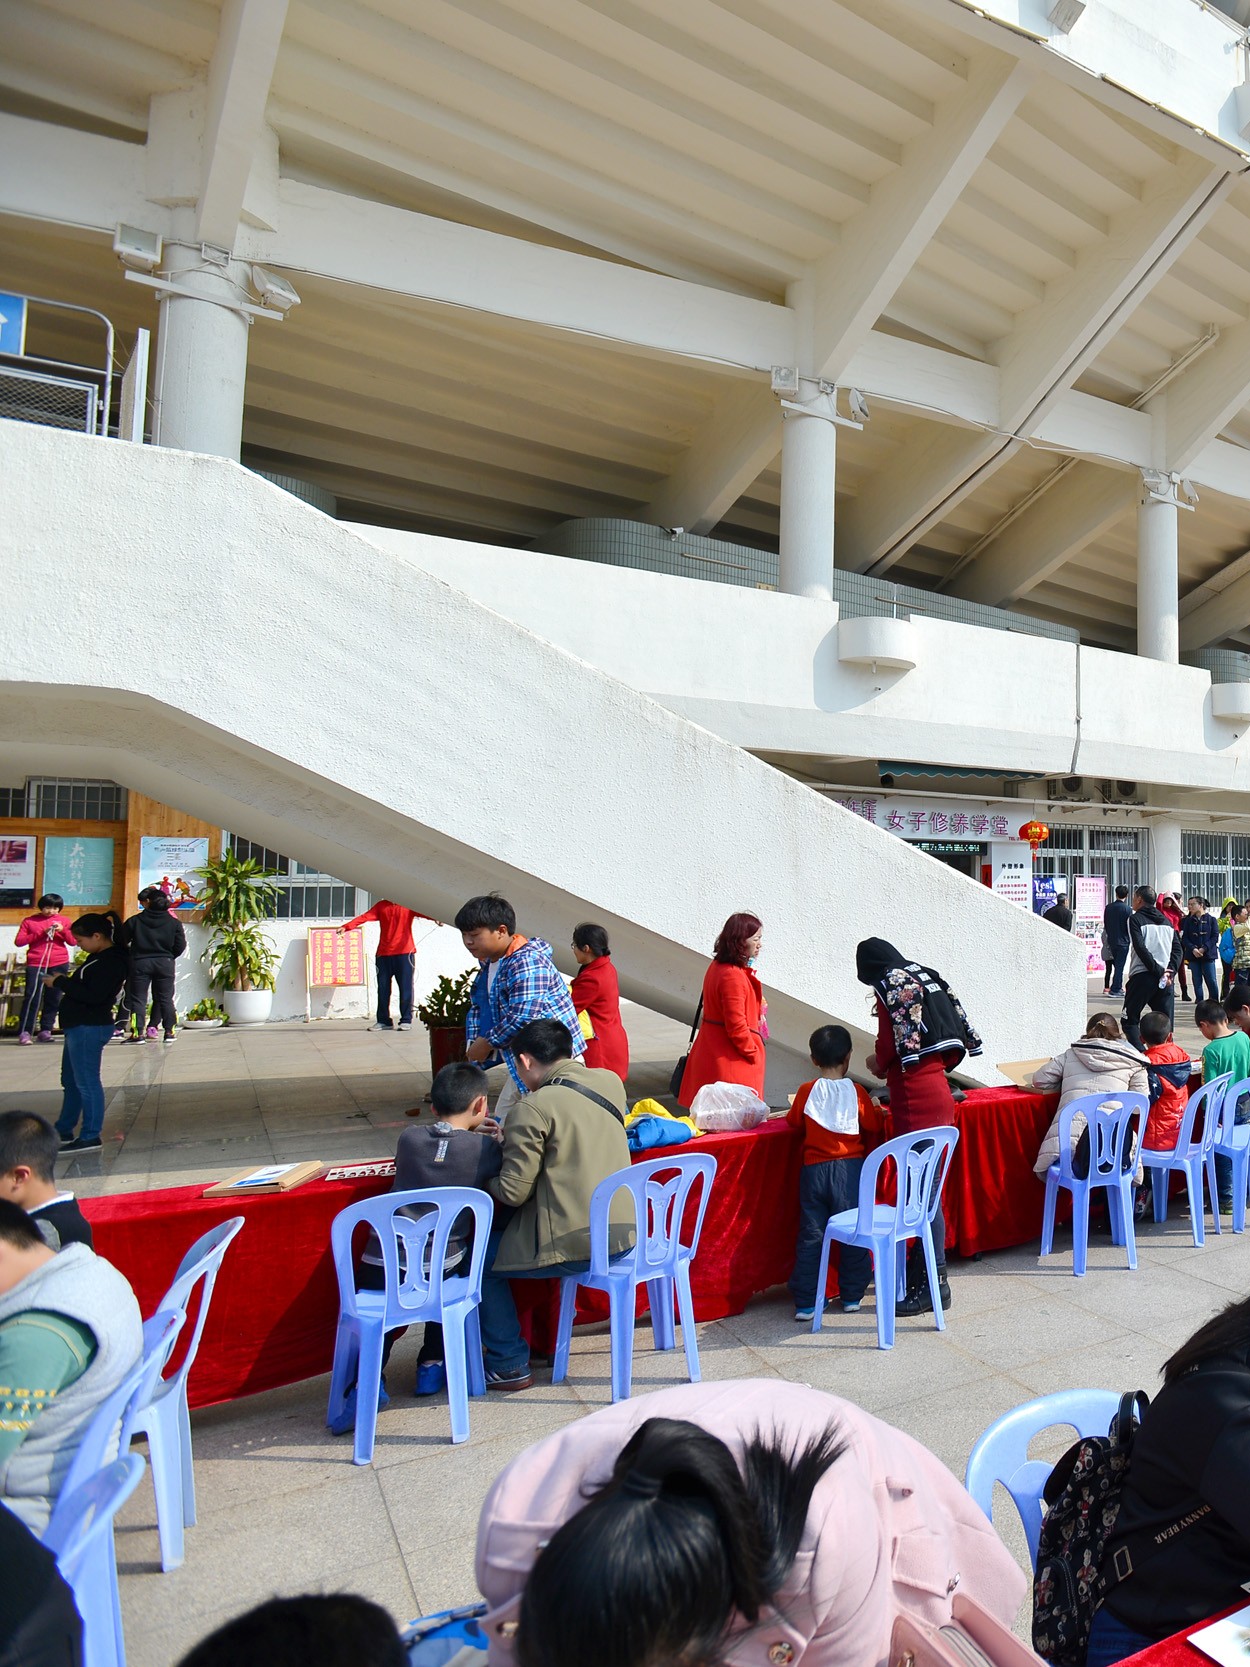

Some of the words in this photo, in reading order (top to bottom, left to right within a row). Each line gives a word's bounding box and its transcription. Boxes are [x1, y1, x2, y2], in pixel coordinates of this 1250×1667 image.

[886, 809, 1009, 836] 女子修养学堂
[1033, 880, 1053, 893] Yes!
[1179, 1504, 1211, 1530] DANNY
[1154, 1521, 1182, 1544] BEAR
